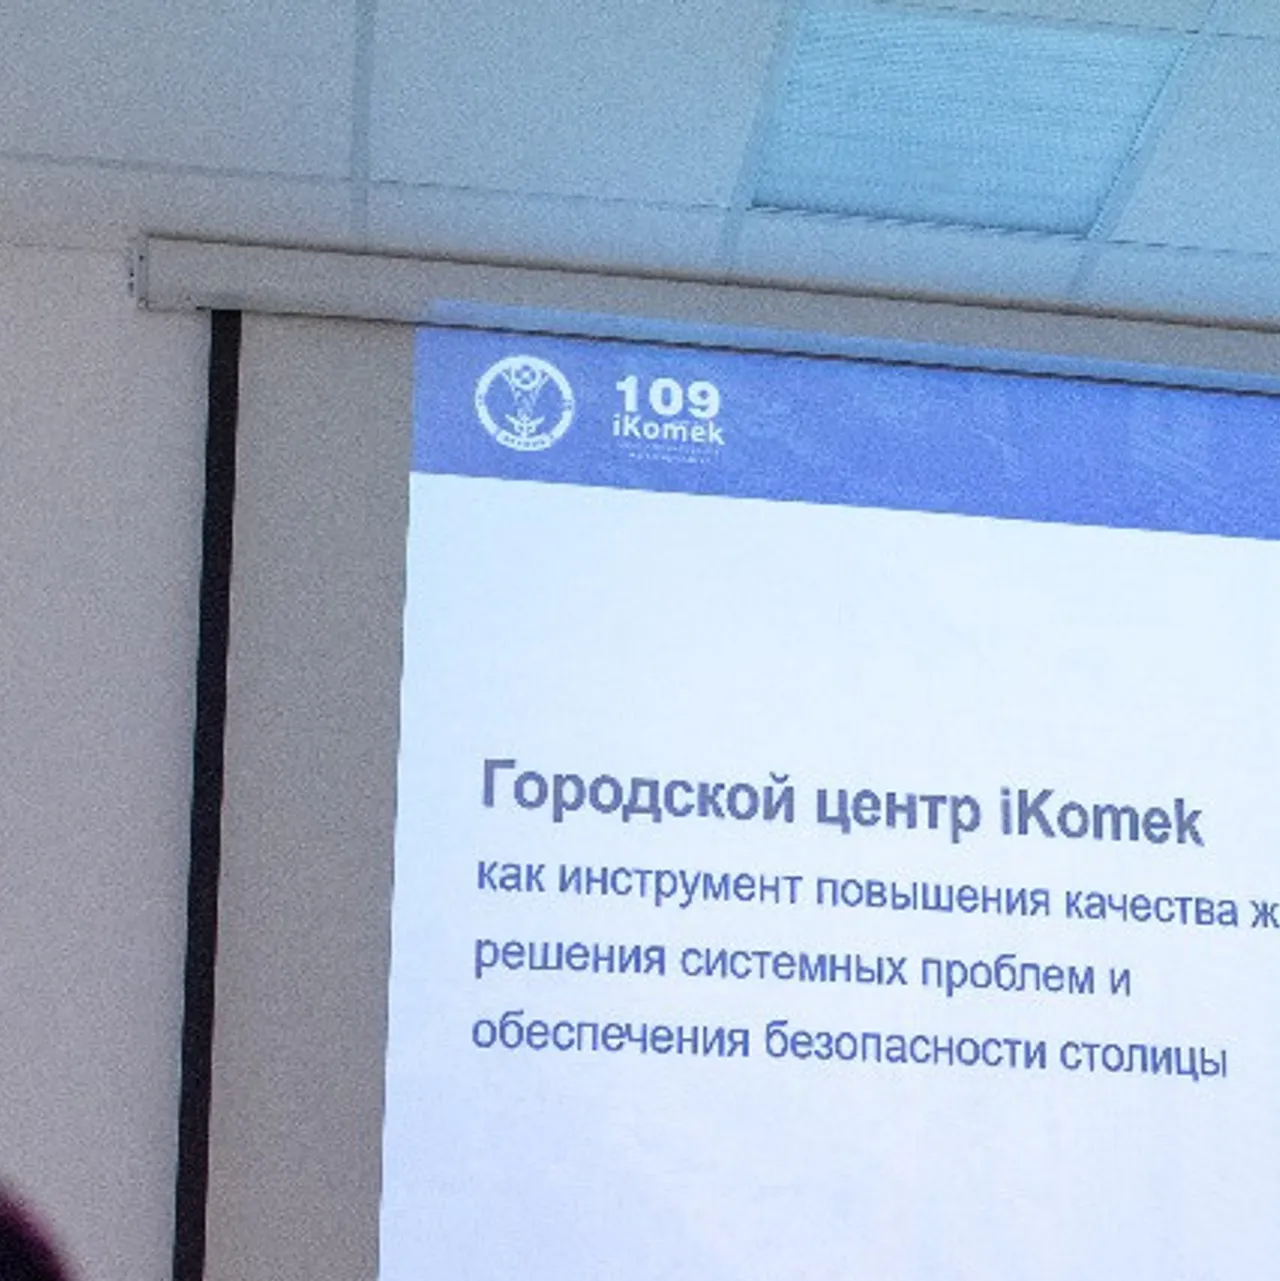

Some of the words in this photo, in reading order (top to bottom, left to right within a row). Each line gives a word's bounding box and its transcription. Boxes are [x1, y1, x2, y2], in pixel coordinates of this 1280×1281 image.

[615, 375, 721, 419] 109
[613, 413, 725, 446] iKomek
[482, 758, 795, 824] Городской
[817, 788, 982, 845] центр
[1000, 786, 1205, 847] iKomek
[477, 860, 546, 893] как
[558, 863, 804, 910] инструмент
[816, 876, 1051, 917] повышения
[1065, 889, 1239, 928] качества
[475, 938, 666, 979] решения
[679, 947, 908, 986] системных
[921, 953, 1095, 998] проблем
[1109, 967, 1131, 997] и
[471, 1009, 750, 1058] обеспечения
[765, 1019, 1047, 1070] безопасности
[1059, 1040, 1227, 1083] столицы
